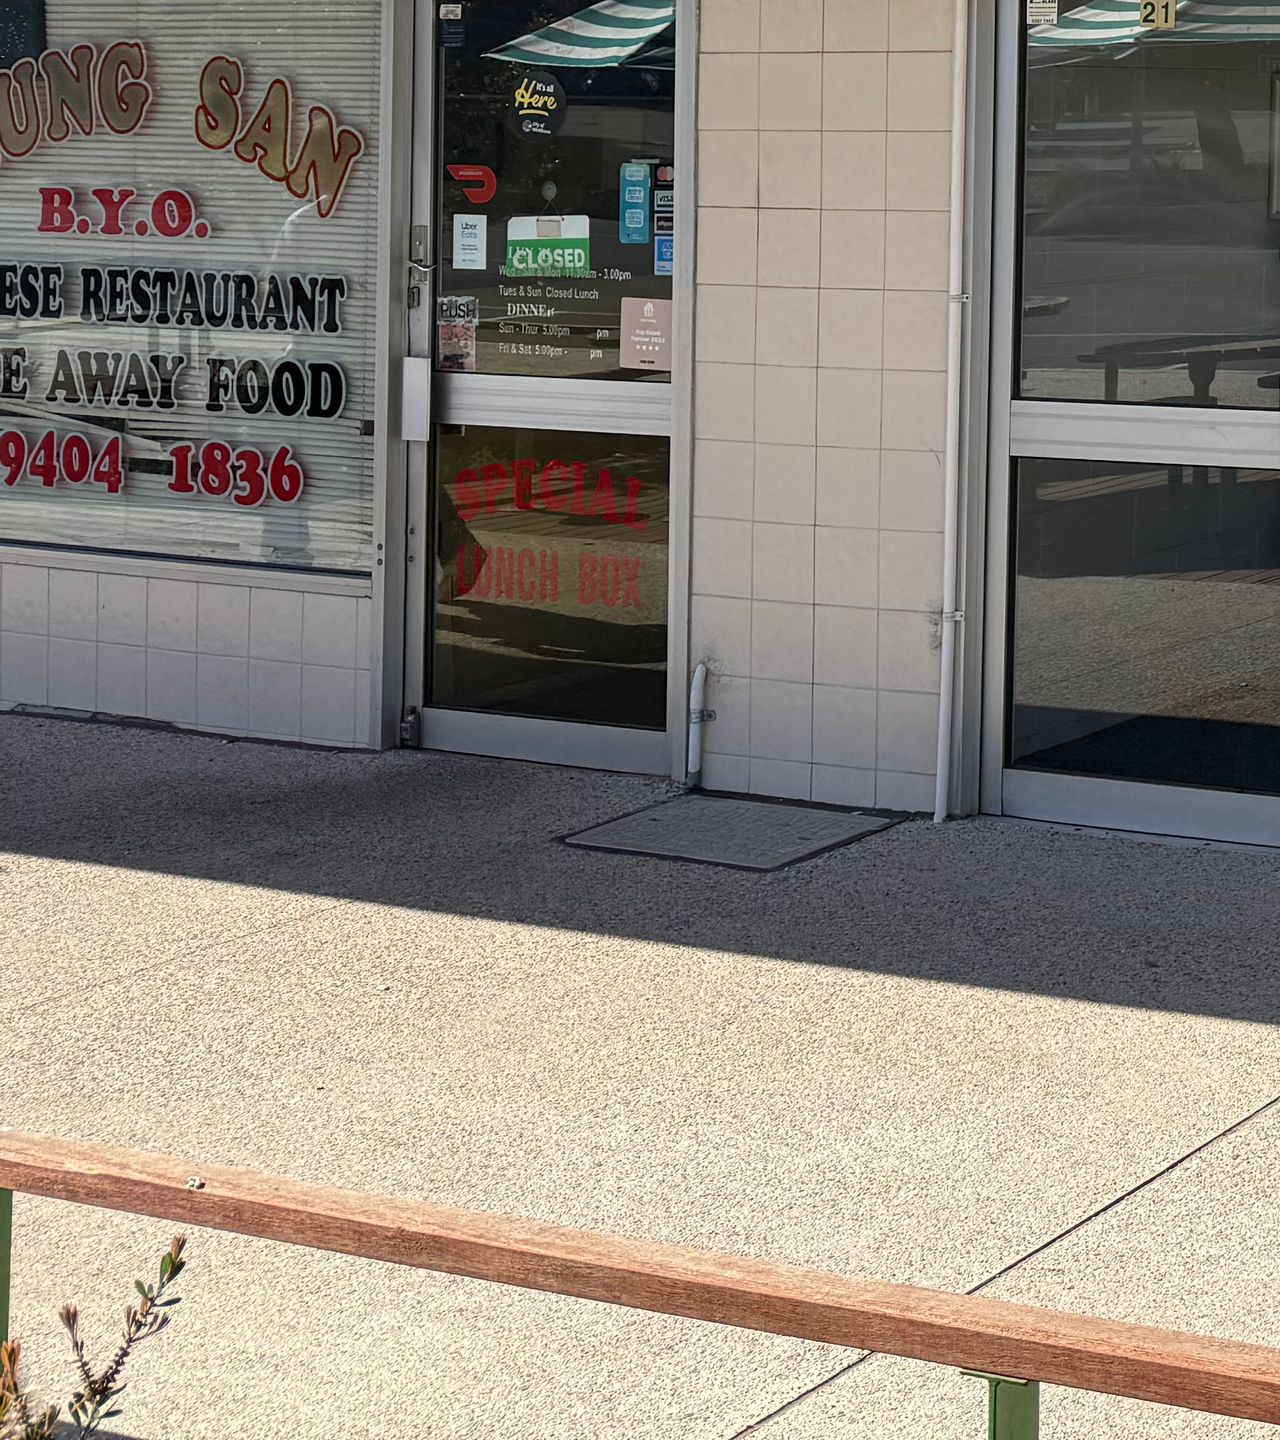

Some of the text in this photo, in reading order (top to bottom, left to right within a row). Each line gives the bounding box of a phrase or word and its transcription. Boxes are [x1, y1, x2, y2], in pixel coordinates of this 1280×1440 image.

[1141, 1, 1170, 24] 21
[515, 78, 557, 109] Here
[194, 54, 365, 219] SAN
[37, 187, 212, 239] B.Y.O.
[461, 222, 478, 230] Uber
[512, 248, 585, 269] CLOSED
[603, 268, 632, 282] 3.00pm
[80, 266, 347, 335] RESTAURANT
[441, 303, 475, 318] PUSH
[499, 285, 599, 300] Tues & Sun Closed Lunch
[46, 349, 185, 410] AWAY
[204, 356, 347, 420] FOOD
[0, 428, 304, 508] 9404 1836
[453, 458, 649, 534] SPECIAL
[455, 544, 643, 610] LUNCH BOX
